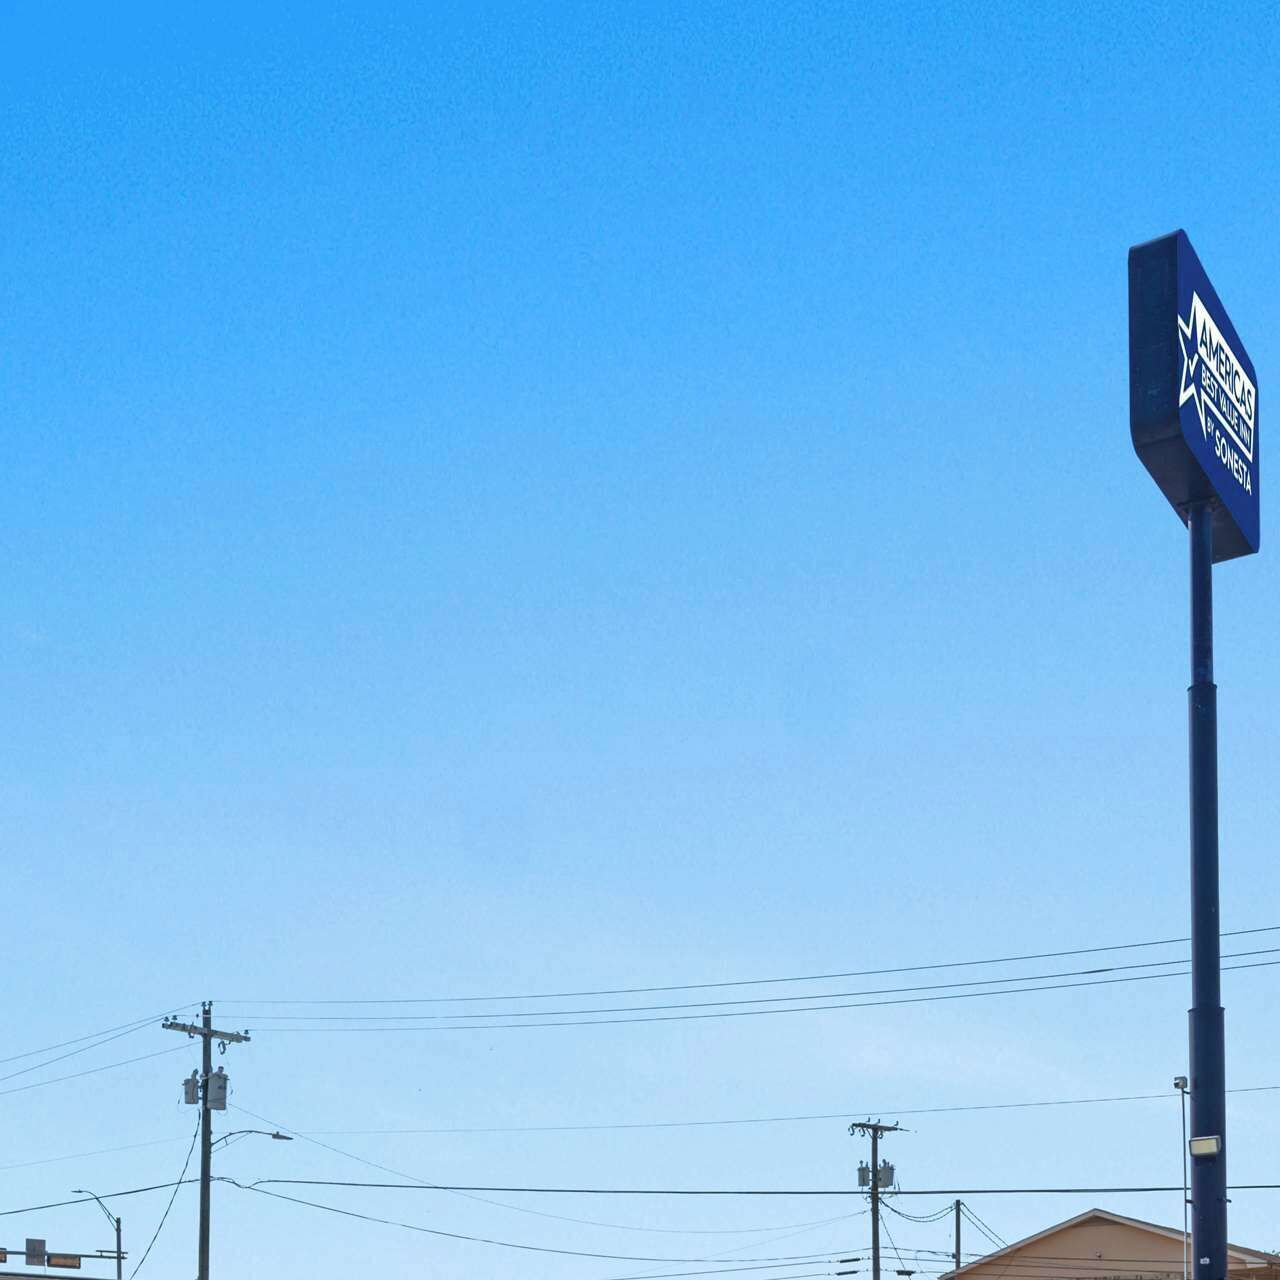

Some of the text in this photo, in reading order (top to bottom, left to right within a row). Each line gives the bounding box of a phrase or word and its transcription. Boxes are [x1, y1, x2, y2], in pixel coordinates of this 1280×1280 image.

[1200, 318, 1252, 420] AMERICAS
[1202, 364, 1251, 447] BEST VALUE INN
[1207, 416, 1252, 496] BY SONESTA
